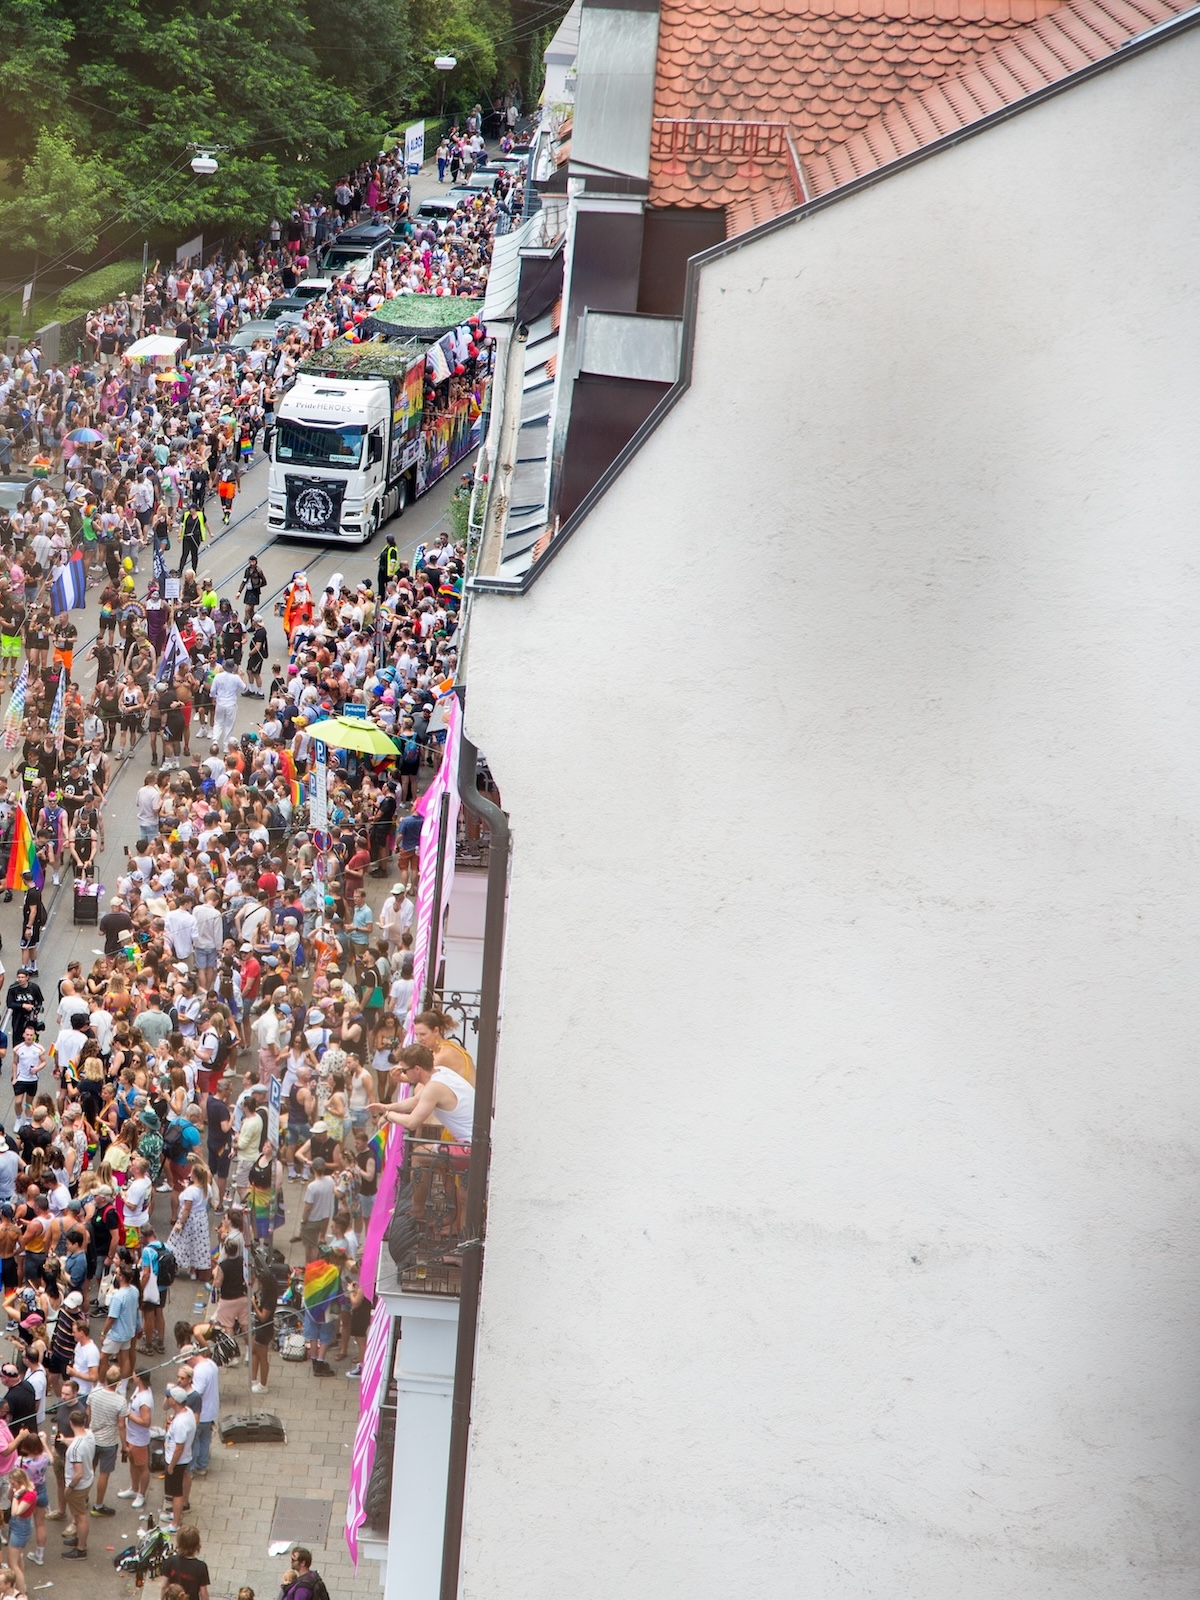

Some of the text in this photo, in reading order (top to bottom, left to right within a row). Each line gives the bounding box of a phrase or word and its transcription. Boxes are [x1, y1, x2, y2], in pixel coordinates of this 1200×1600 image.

[300, 508, 326, 522] MLC
[317, 742, 324, 760] P
[272, 1081, 279, 1103] P
